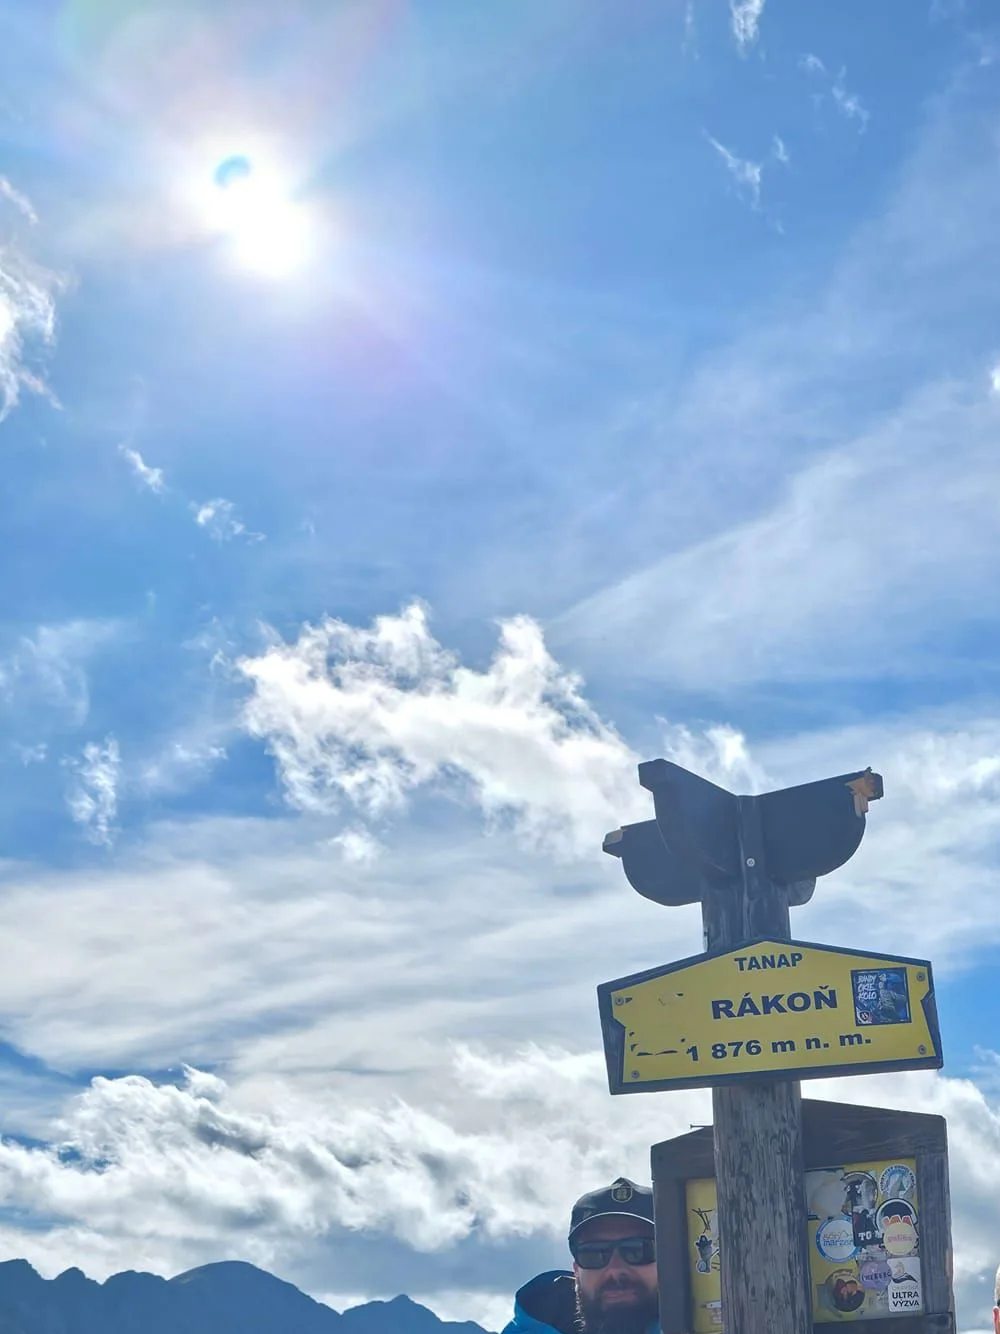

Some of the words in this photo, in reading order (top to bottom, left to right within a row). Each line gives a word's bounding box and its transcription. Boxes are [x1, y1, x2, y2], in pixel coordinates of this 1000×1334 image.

[734, 952, 803, 972] TANAP
[711, 985, 838, 1020] RÁKOŇ
[687, 1045, 699, 1061] 1
[711, 1039, 762, 1059] 876
[771, 1038, 796, 1054] m
[805, 1036, 829, 1050] n.
[839, 1032, 872, 1047] m.
[891, 1291, 920, 1300] ULTRA
